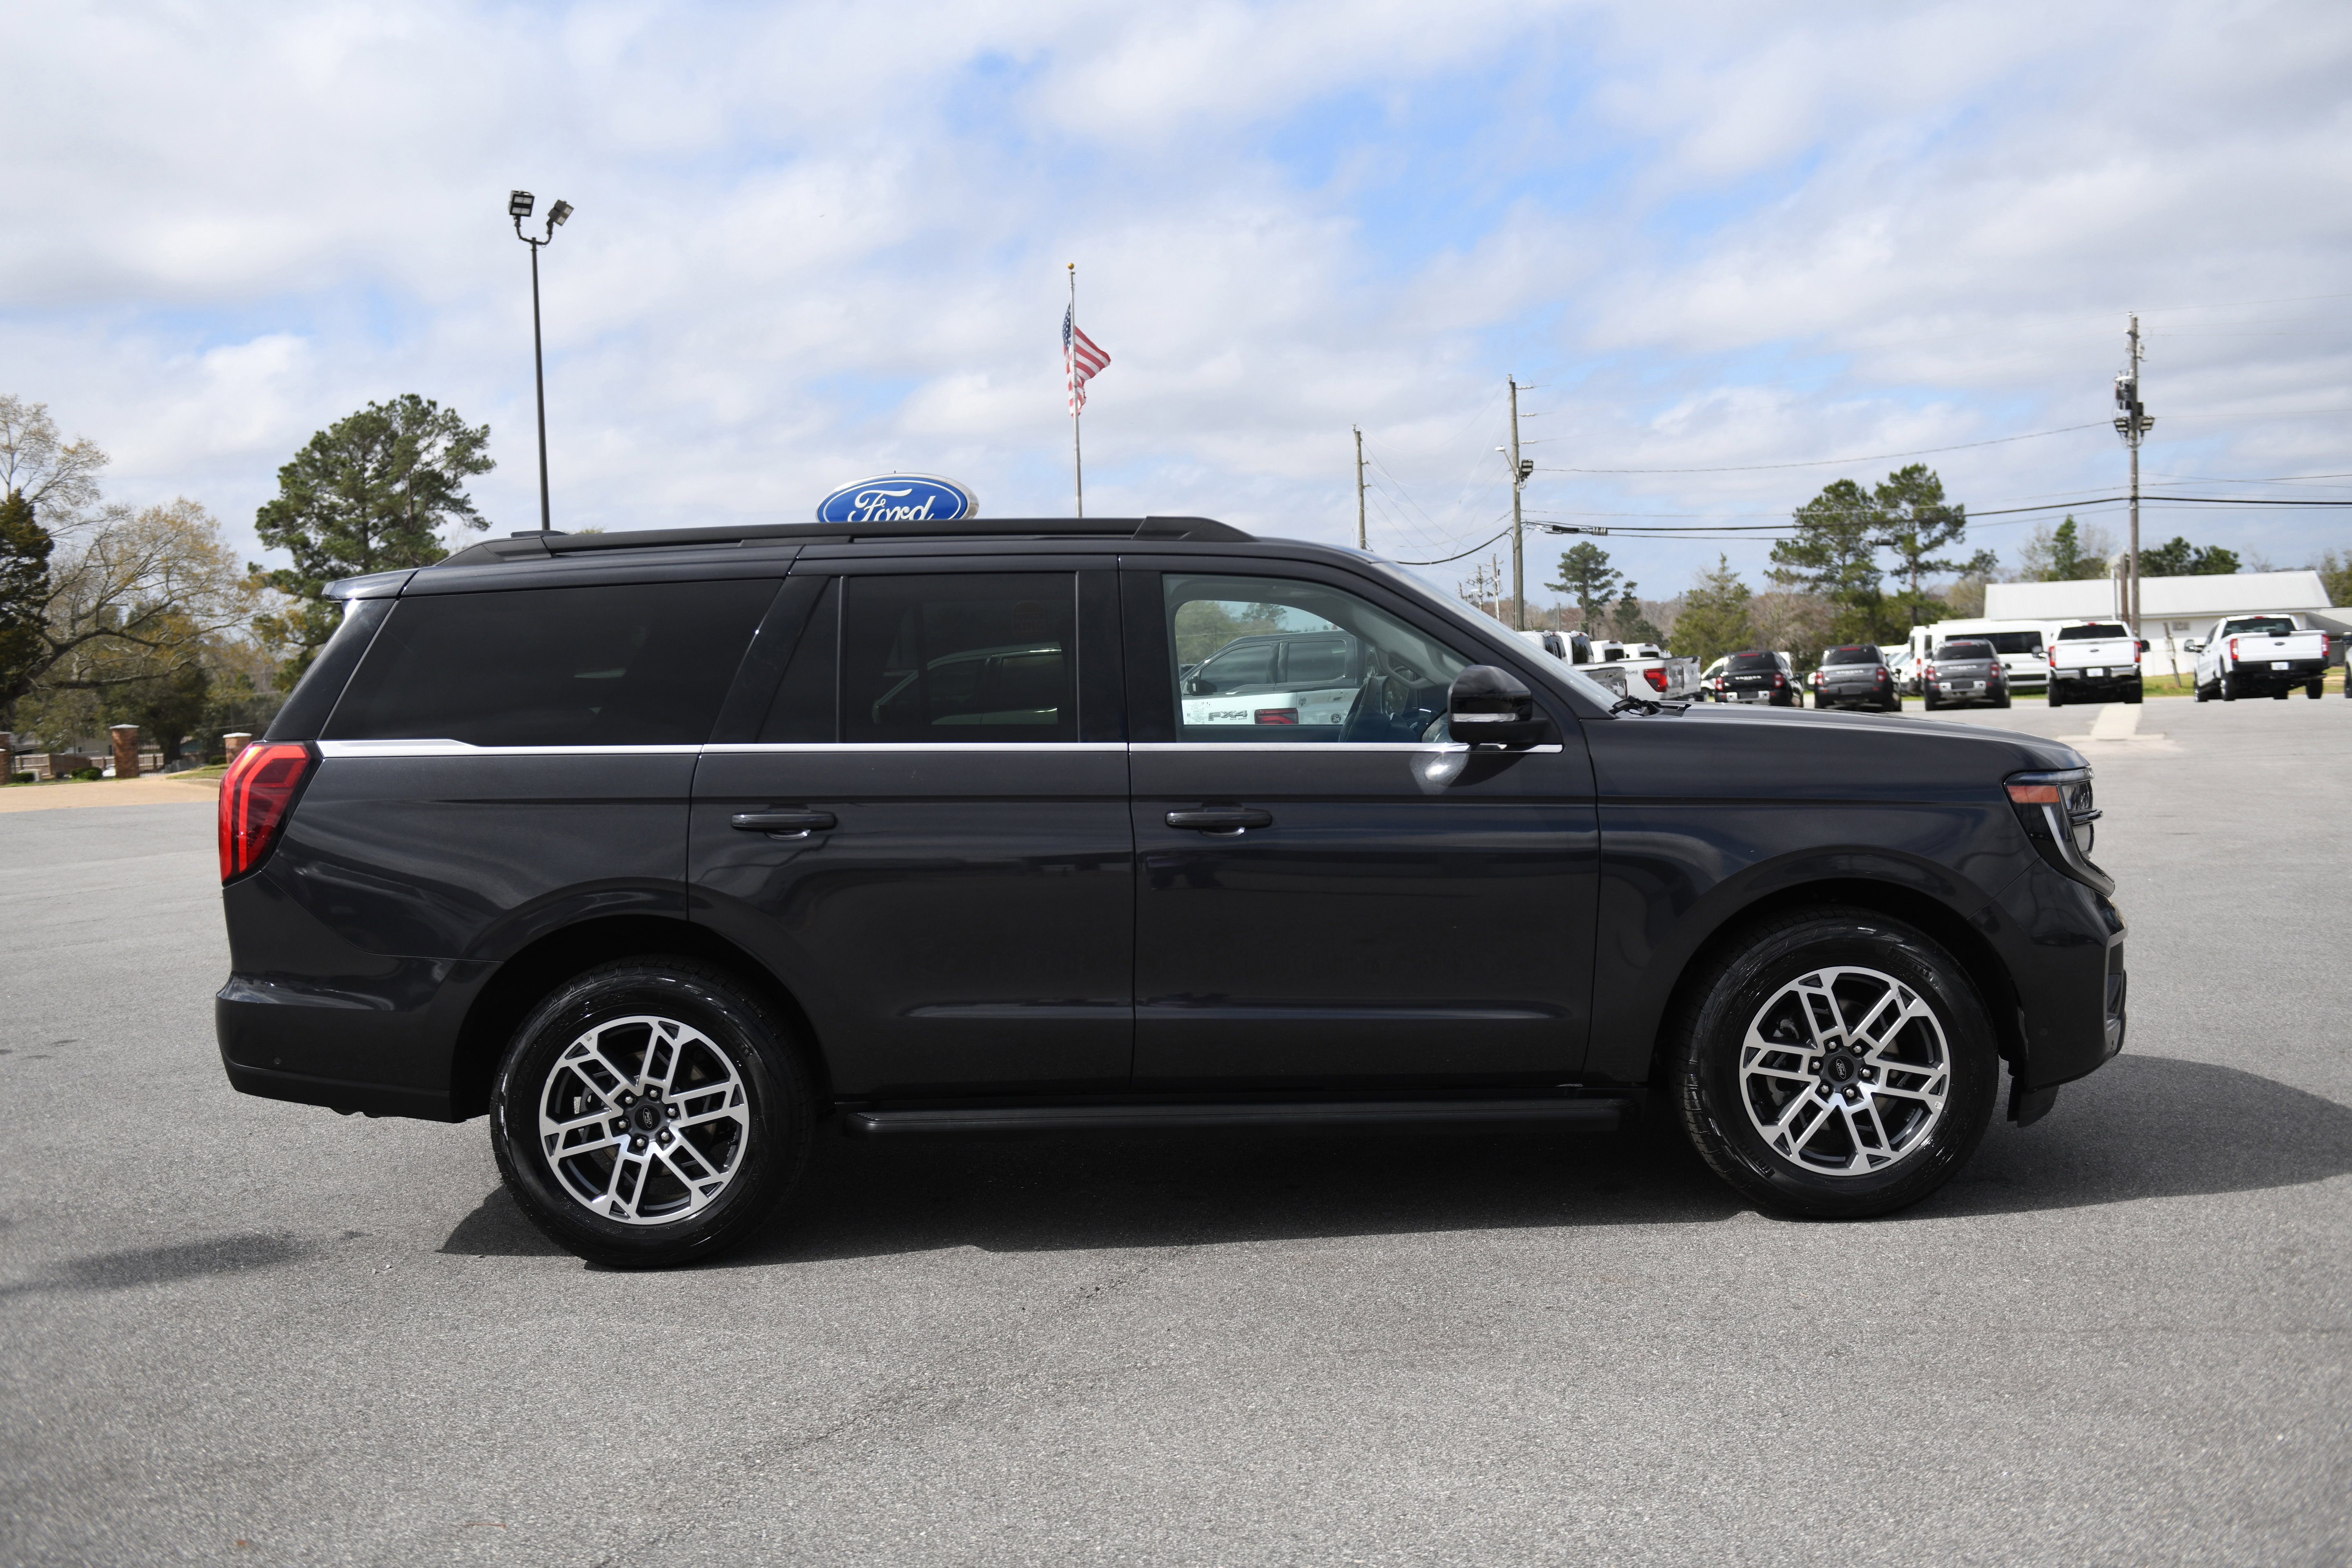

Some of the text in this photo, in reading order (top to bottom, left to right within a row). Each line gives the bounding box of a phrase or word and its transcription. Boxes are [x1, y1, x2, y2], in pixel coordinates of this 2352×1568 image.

[847, 488, 936, 522] Ford
[1208, 710, 1247, 721] FX4
[1837, 1062, 1845, 1076] Ford
